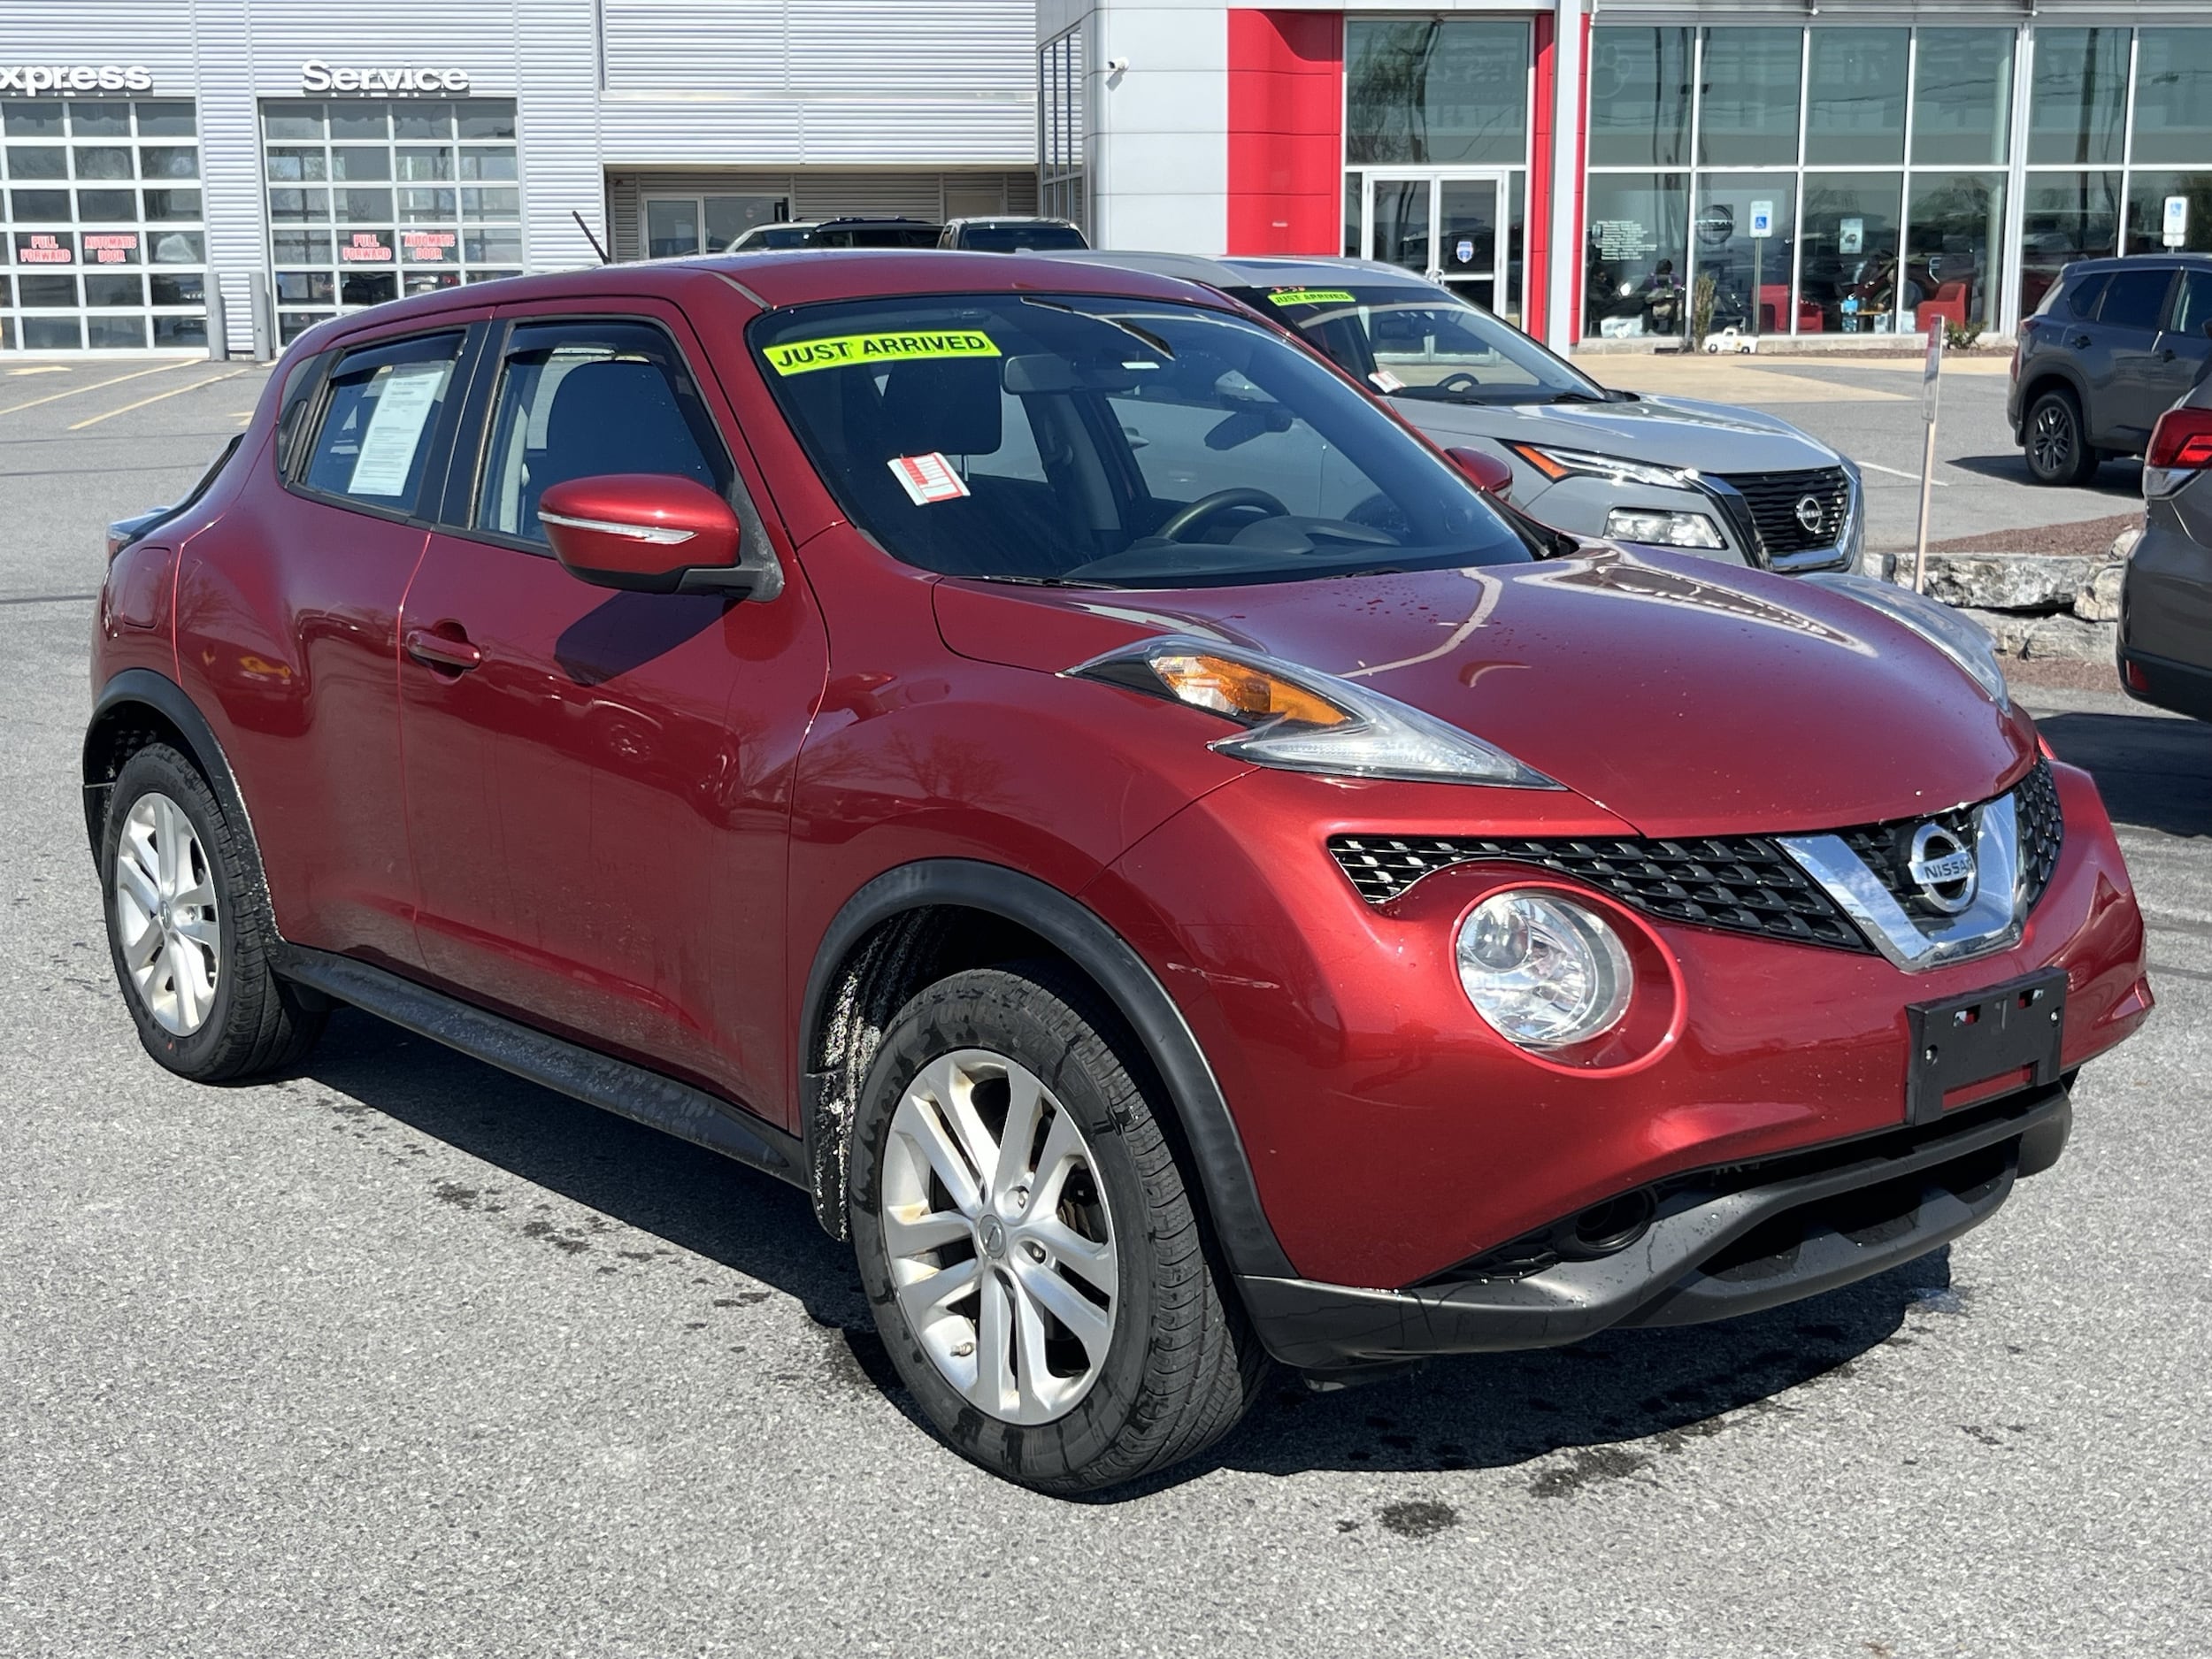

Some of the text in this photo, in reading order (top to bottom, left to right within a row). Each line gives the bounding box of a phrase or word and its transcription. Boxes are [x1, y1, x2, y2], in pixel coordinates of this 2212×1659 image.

[302, 59, 470, 91] Service
[31, 235, 58, 249] PULL
[84, 235, 137, 249] AUTOMATIC
[354, 234, 380, 247] PULL
[404, 234, 455, 247] AUTOMATIC
[20, 249, 71, 263] FORWARD
[97, 249, 126, 263] DOOR
[342, 247, 391, 260] FORWARD
[416, 247, 443, 260] DOOR
[1275, 295, 1301, 303] JUST
[778, 335, 986, 367] JUST ARRIVED
[1924, 858, 1972, 879] NISSAN
